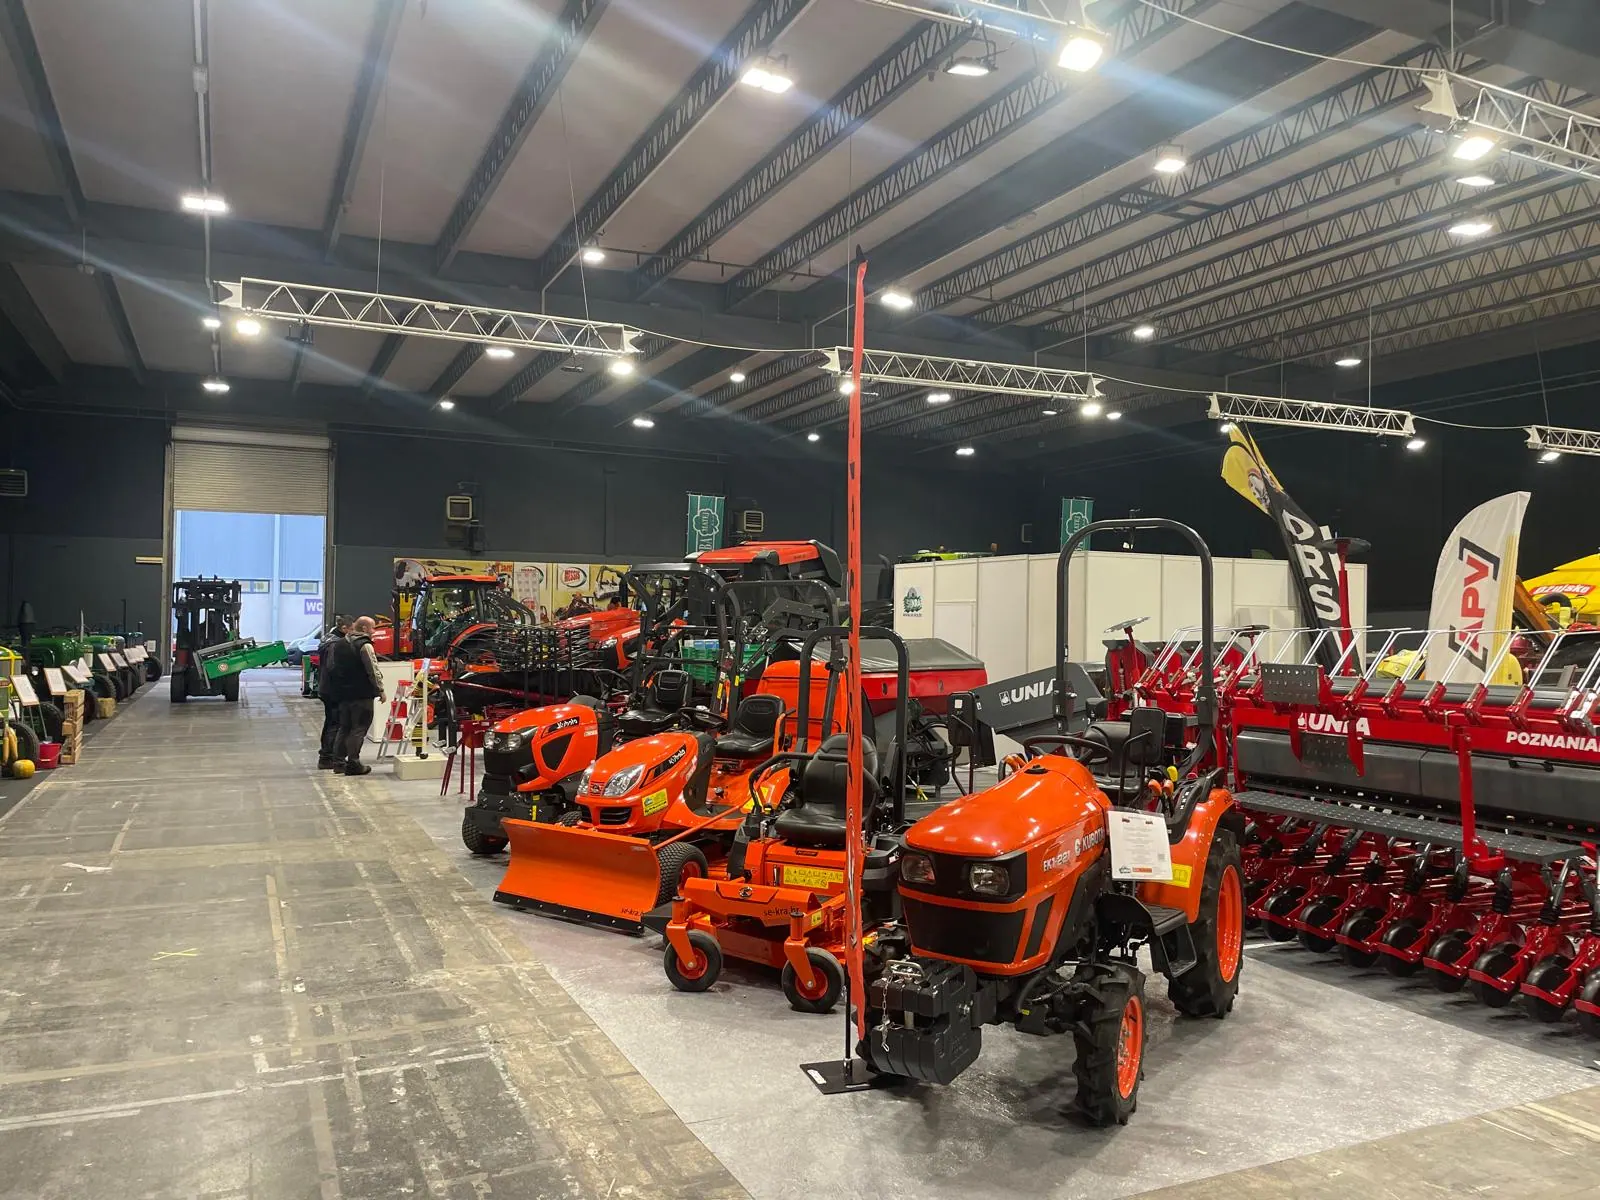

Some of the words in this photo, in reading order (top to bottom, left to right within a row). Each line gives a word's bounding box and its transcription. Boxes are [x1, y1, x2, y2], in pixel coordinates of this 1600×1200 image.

[306, 602, 323, 612] WC
[1458, 554, 1489, 653] APV
[1506, 731, 1600, 753] POZNANIA
